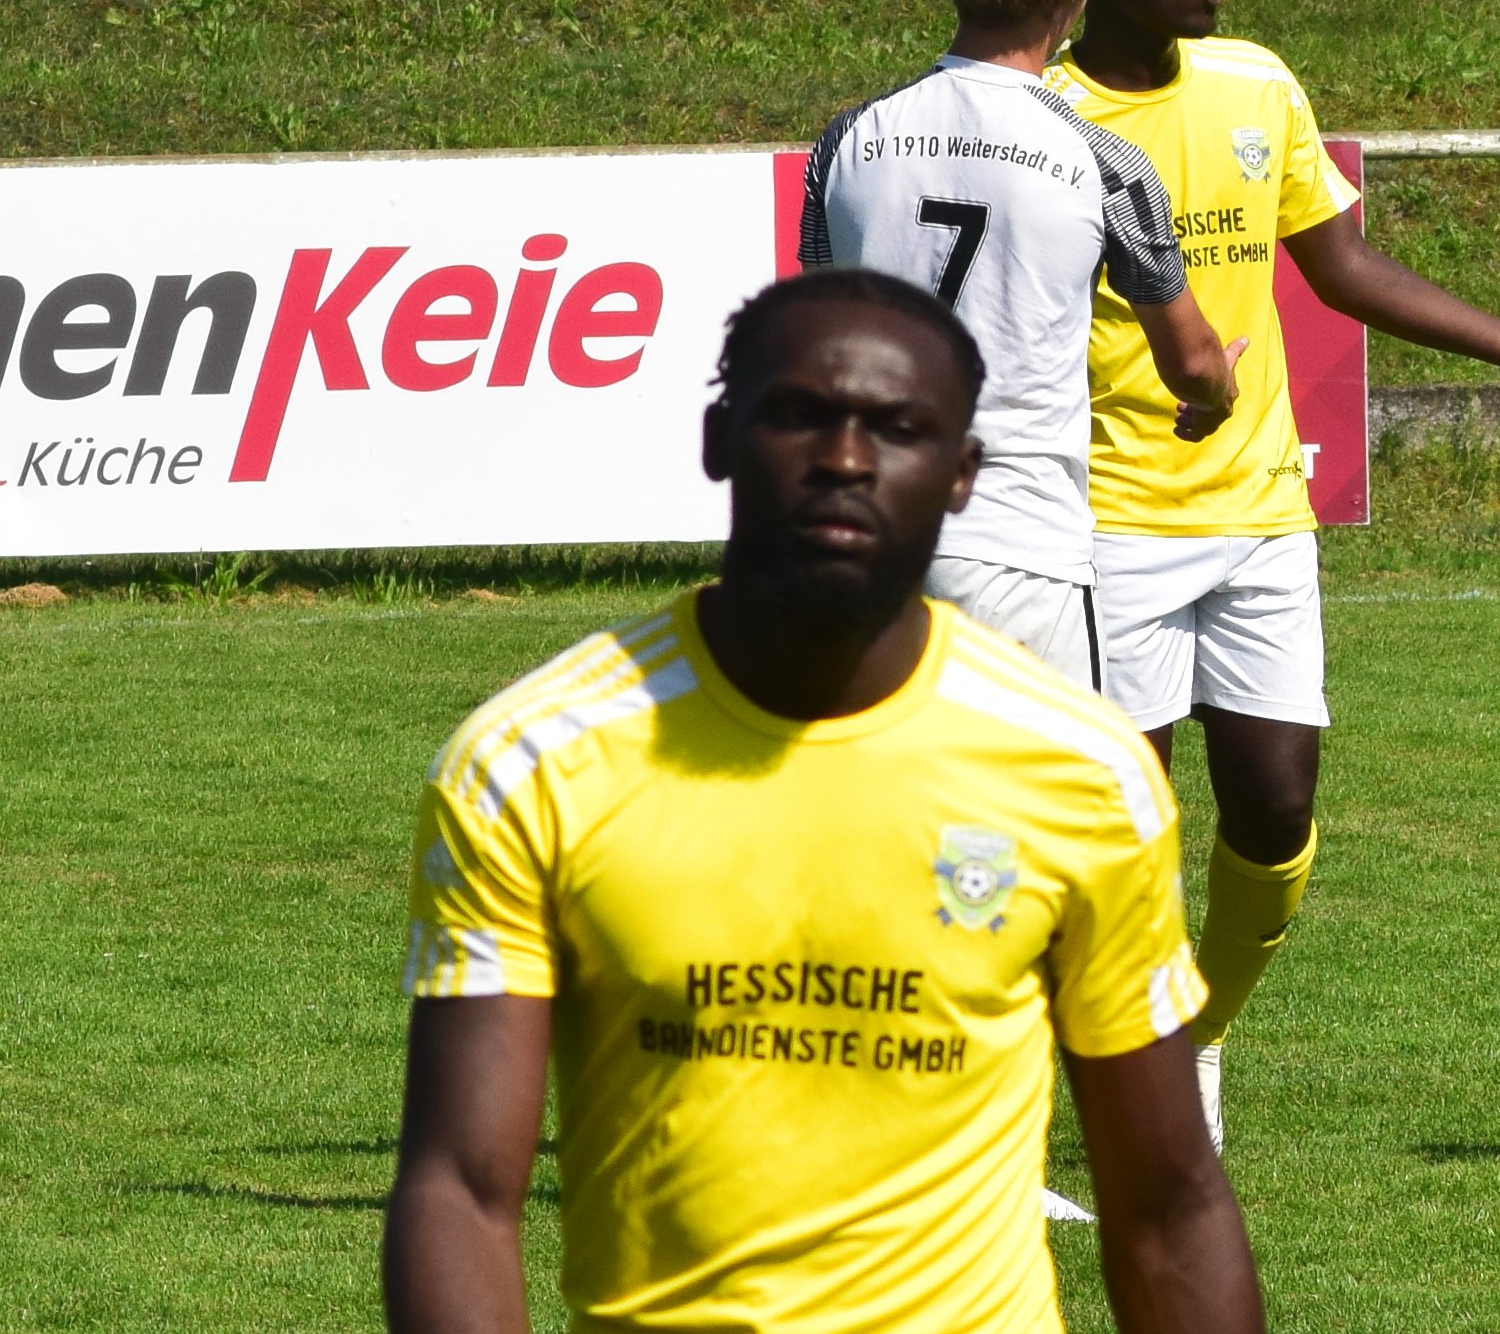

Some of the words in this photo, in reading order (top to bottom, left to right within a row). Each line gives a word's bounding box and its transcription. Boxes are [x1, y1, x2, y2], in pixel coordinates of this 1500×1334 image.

[863, 137, 886, 162] SV
[892, 135, 940, 158] 1910
[947, 135, 1048, 172] Weiterstadt
[1173, 207, 1246, 239] SISCHE
[915, 195, 992, 313] 7
[1227, 241, 1269, 264] GMBH
[17, 436, 204, 488] Küche
[685, 961, 925, 1014] HESSISCHE
[638, 1017, 861, 1068] BAHNDIENSTE
[873, 1034, 967, 1073] GMBH
